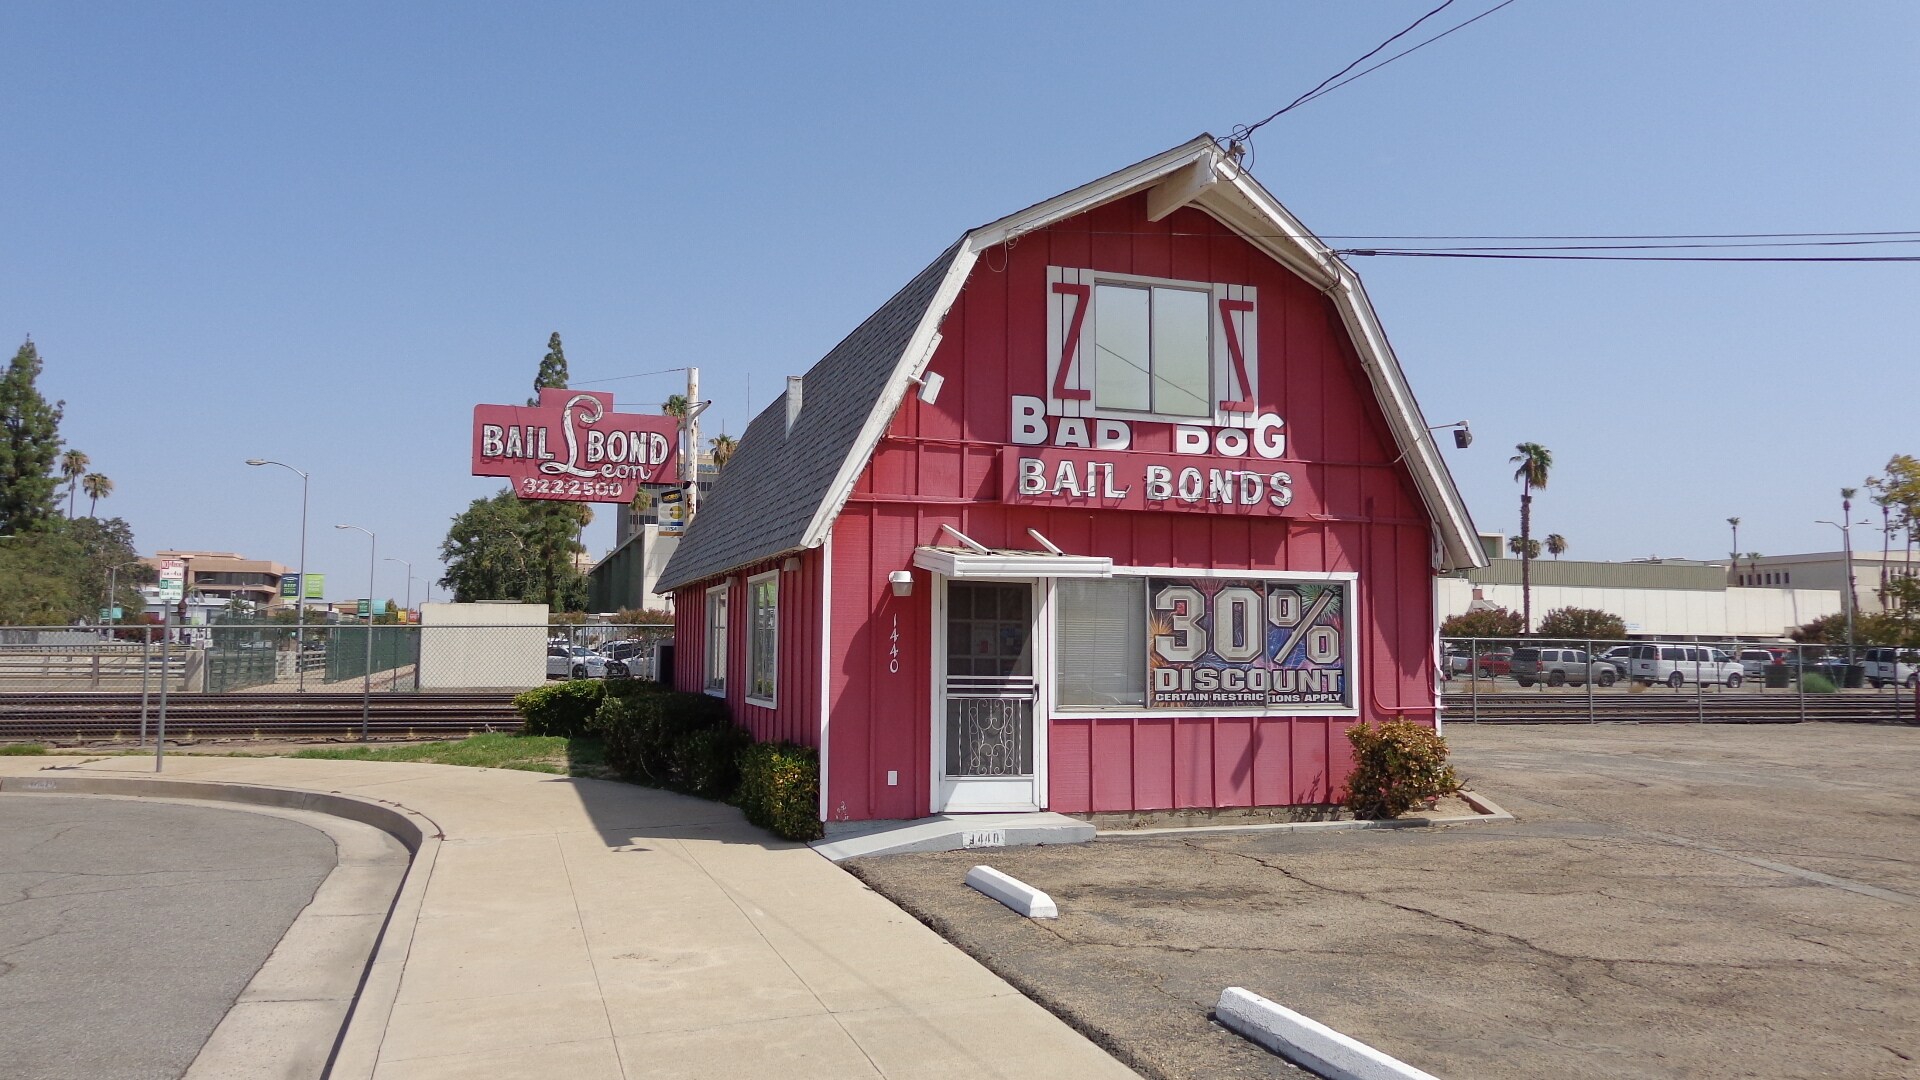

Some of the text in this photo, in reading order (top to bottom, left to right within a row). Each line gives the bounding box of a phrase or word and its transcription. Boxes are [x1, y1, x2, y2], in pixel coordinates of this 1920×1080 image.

[482, 424, 669, 465] BAIL BOND
[539, 395, 652, 480] Leon
[1011, 395, 1286, 459] BAD DOG
[1018, 457, 1293, 508] BAIL BONDS
[889, 613, 899, 674] 1440
[1154, 585, 1340, 665] 30%
[1154, 668, 1343, 693] DISCOUNT
[1155, 693, 1342, 703] CERTAIN RESTRICTIONS APPLY
